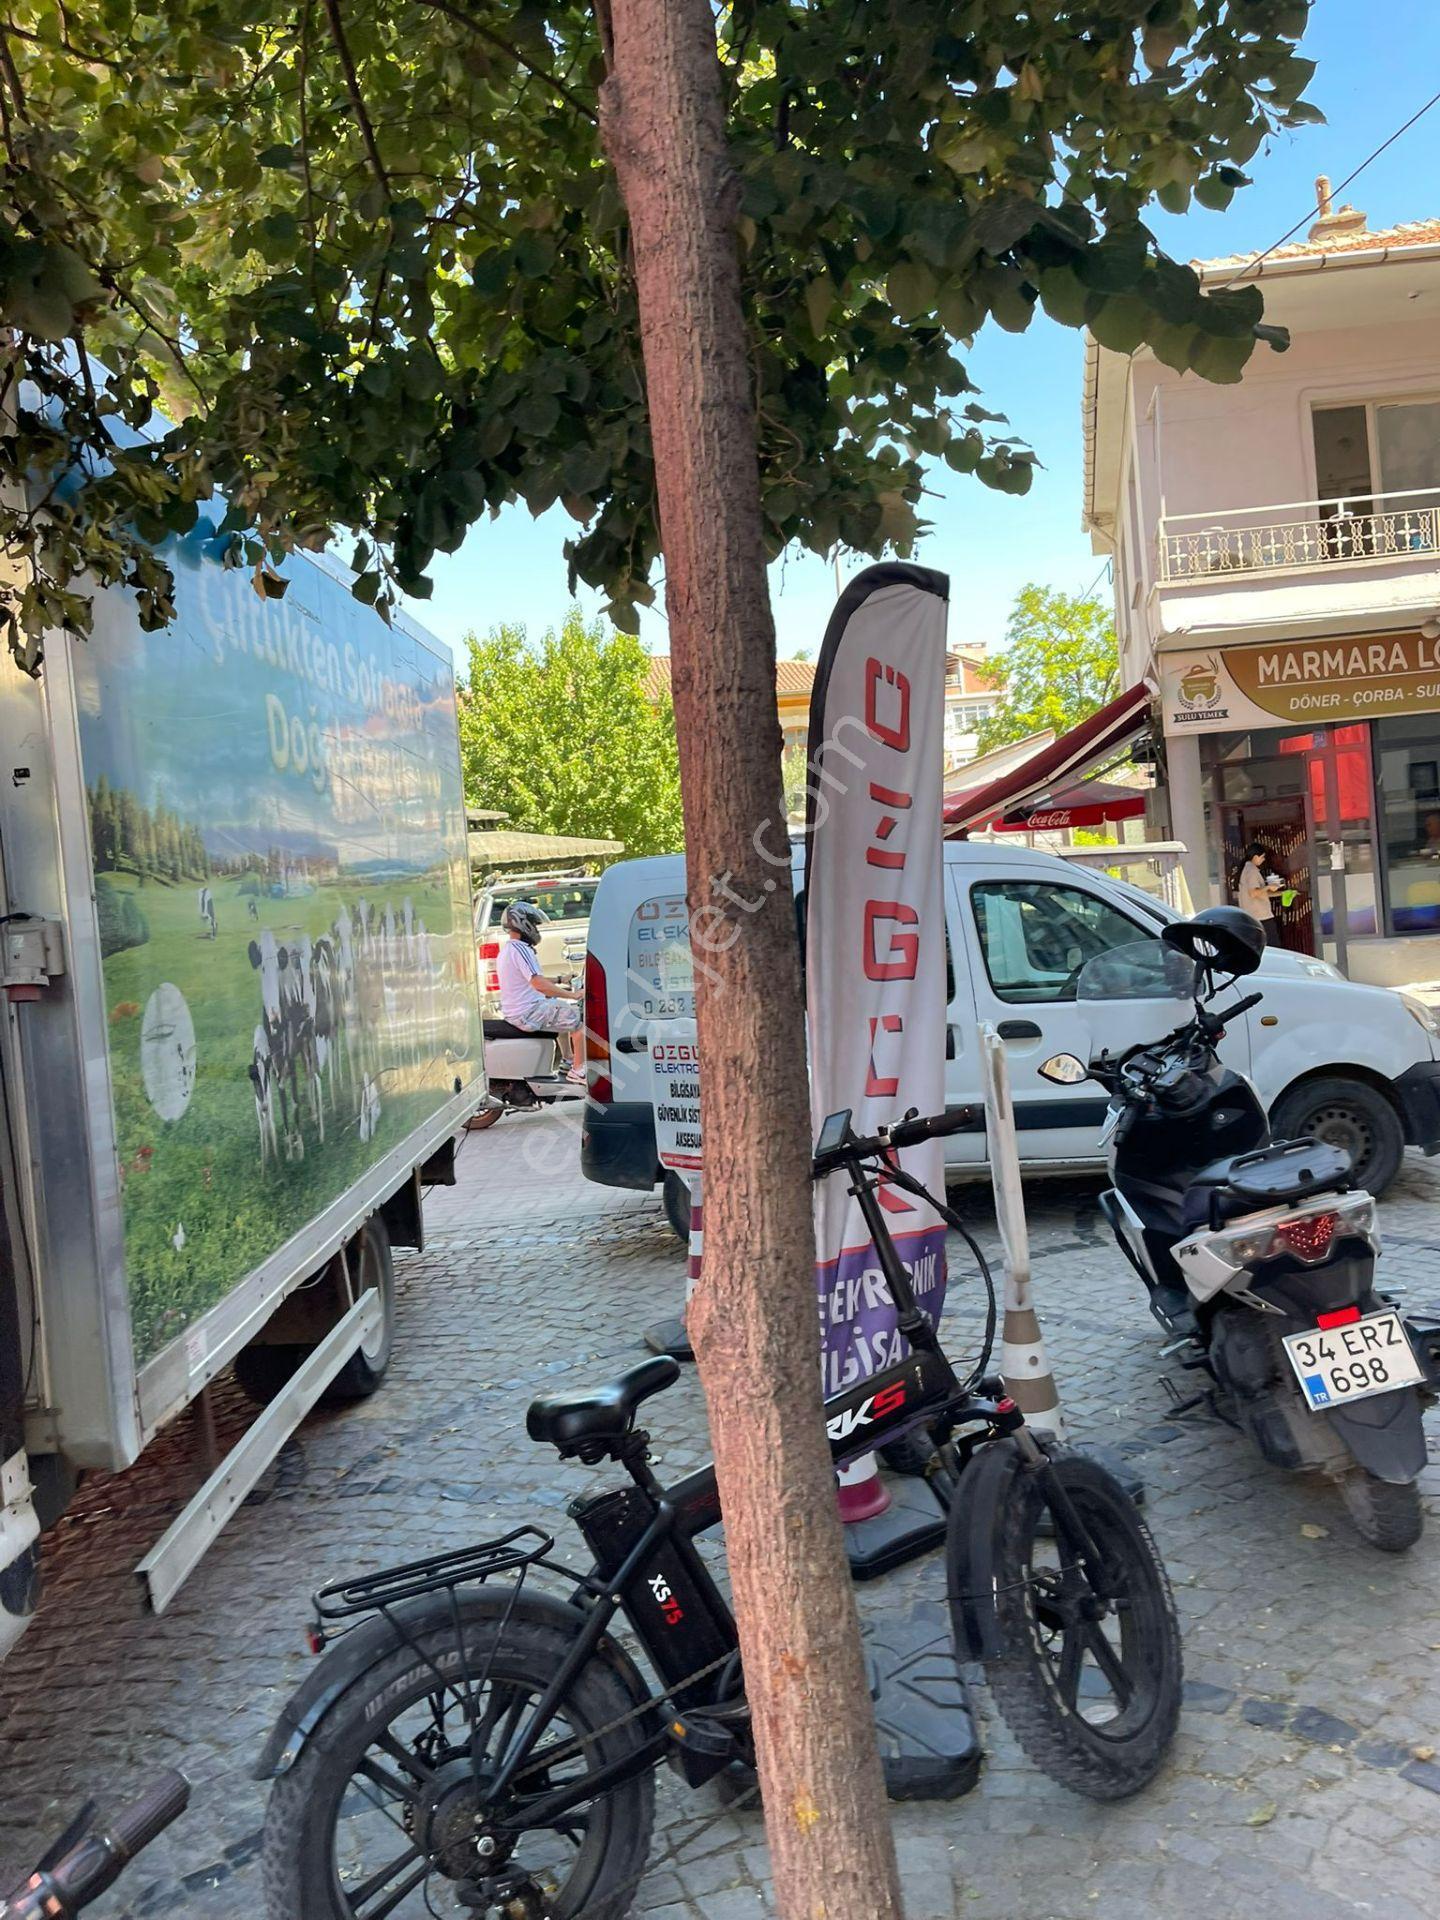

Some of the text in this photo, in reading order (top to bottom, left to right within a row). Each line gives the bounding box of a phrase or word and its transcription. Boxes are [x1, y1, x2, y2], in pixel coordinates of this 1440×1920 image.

[1258, 642, 1409, 683] MARMARA
[1289, 693, 1341, 710] DÖNER
[1352, 687, 1404, 707] ÇORBA
[1296, 1319, 1402, 1367] 34 ERZ
[1330, 1357, 1389, 1393] 698
[1313, 1391, 1329, 1402] TR
